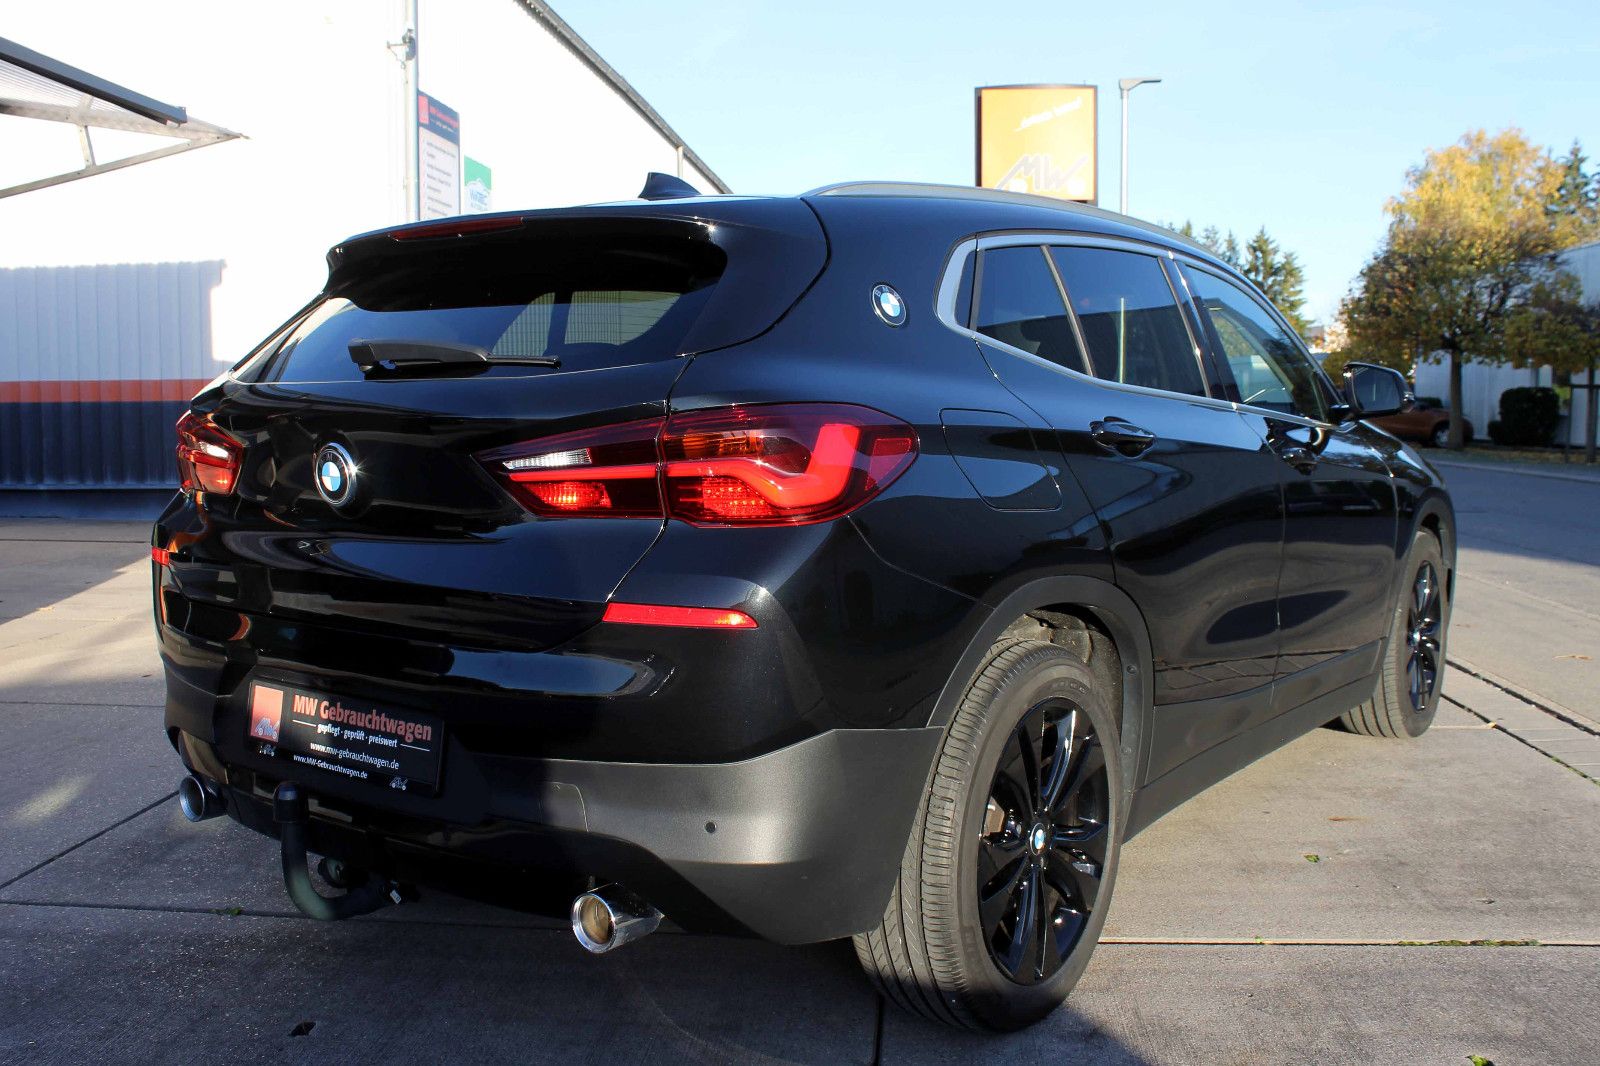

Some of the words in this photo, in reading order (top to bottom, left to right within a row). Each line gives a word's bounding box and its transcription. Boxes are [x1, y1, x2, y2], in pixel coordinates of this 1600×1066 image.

[293, 694, 318, 717] MW
[320, 700, 432, 743] Gebrauchtwagen
[317, 723, 340, 737] gepflegt
[344, 729, 365, 741] geprüft
[368, 735, 398, 748] preiswert
[310, 742, 400, 770] www.mw-gebrauchtwagen.de
